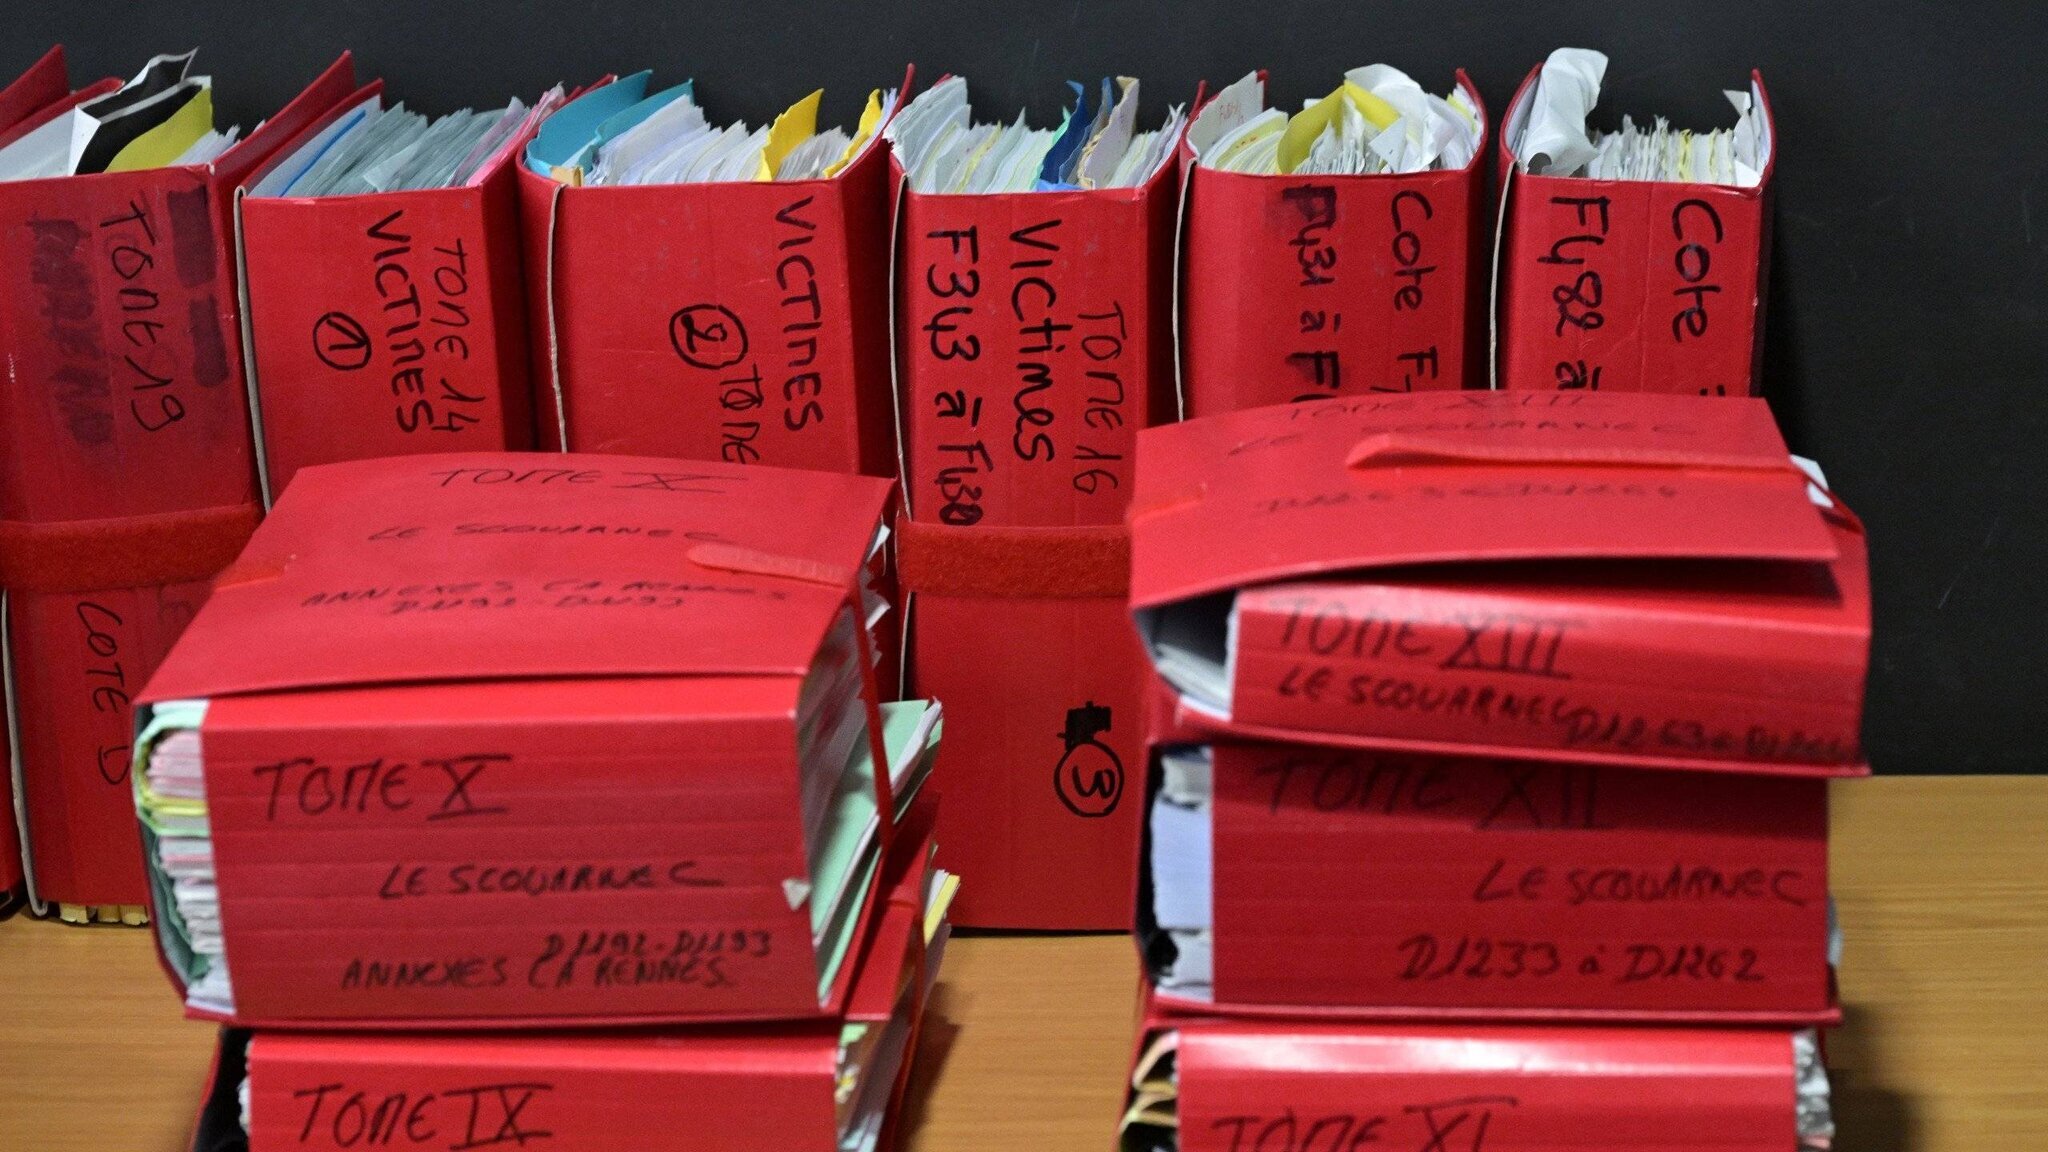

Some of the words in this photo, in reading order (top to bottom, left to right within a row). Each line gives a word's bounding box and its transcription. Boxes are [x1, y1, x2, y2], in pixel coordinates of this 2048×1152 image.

[924, 225, 981, 362] F343
[1672, 198, 1723, 343] Cote
[367, 210, 434, 432] VICTIMES
[124, 357, 187, 432] 19
[432, 378, 486, 432] 14
[431, 467, 603, 488] TOME
[1073, 445, 1123, 494] 16
[1271, 597, 1430, 661] TOME
[254, 757, 409, 821] TOME
[420, 754, 513, 821] X
[378, 865, 430, 901] LE
[1397, 933, 1562, 981] D1233
[1615, 942, 1765, 983] D1262
[294, 1082, 437, 1148] TOME
[443, 1082, 553, 1151] IX
